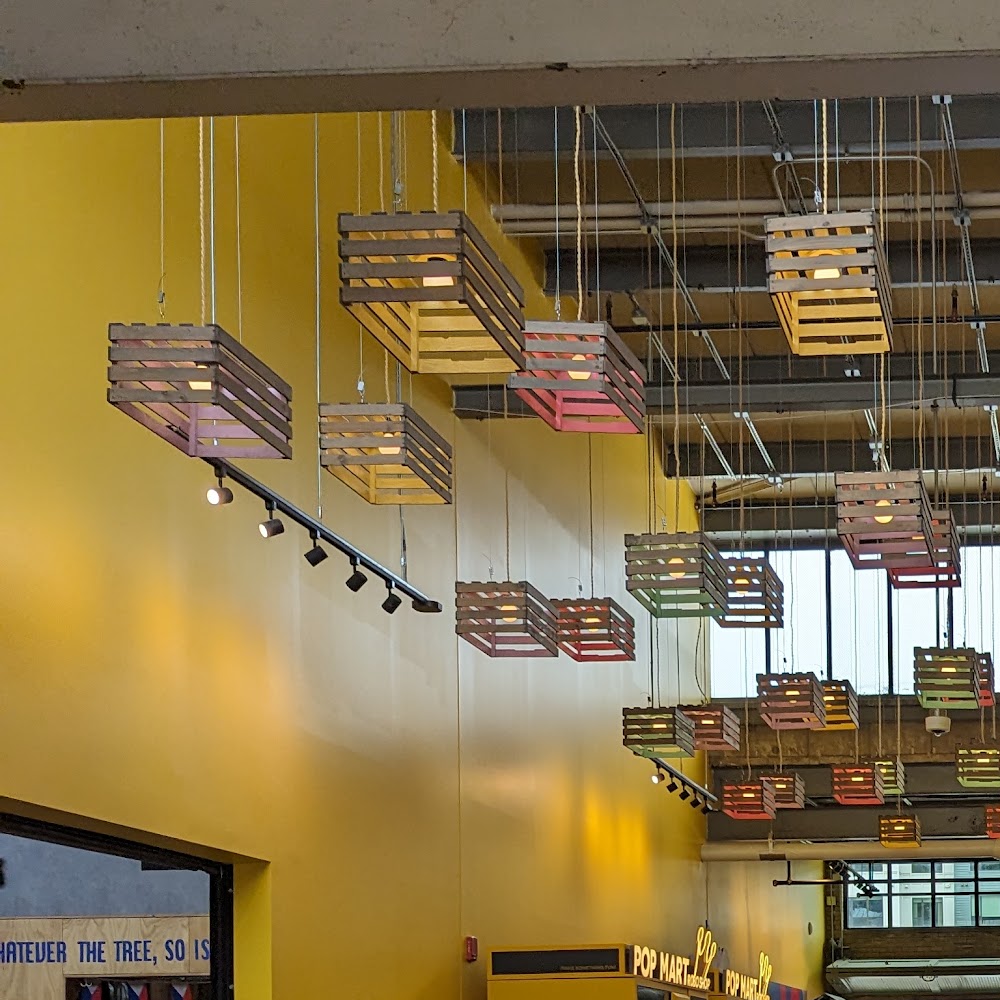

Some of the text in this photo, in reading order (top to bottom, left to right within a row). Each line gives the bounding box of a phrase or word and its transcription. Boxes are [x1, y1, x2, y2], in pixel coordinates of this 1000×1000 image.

[77, 941, 106, 963] THE
[114, 940, 158, 966] TREE,
[165, 938, 185, 961] SO
[194, 938, 210, 961] IS
[633, 944, 690, 986] POP MART
[726, 968, 740, 997] POP
